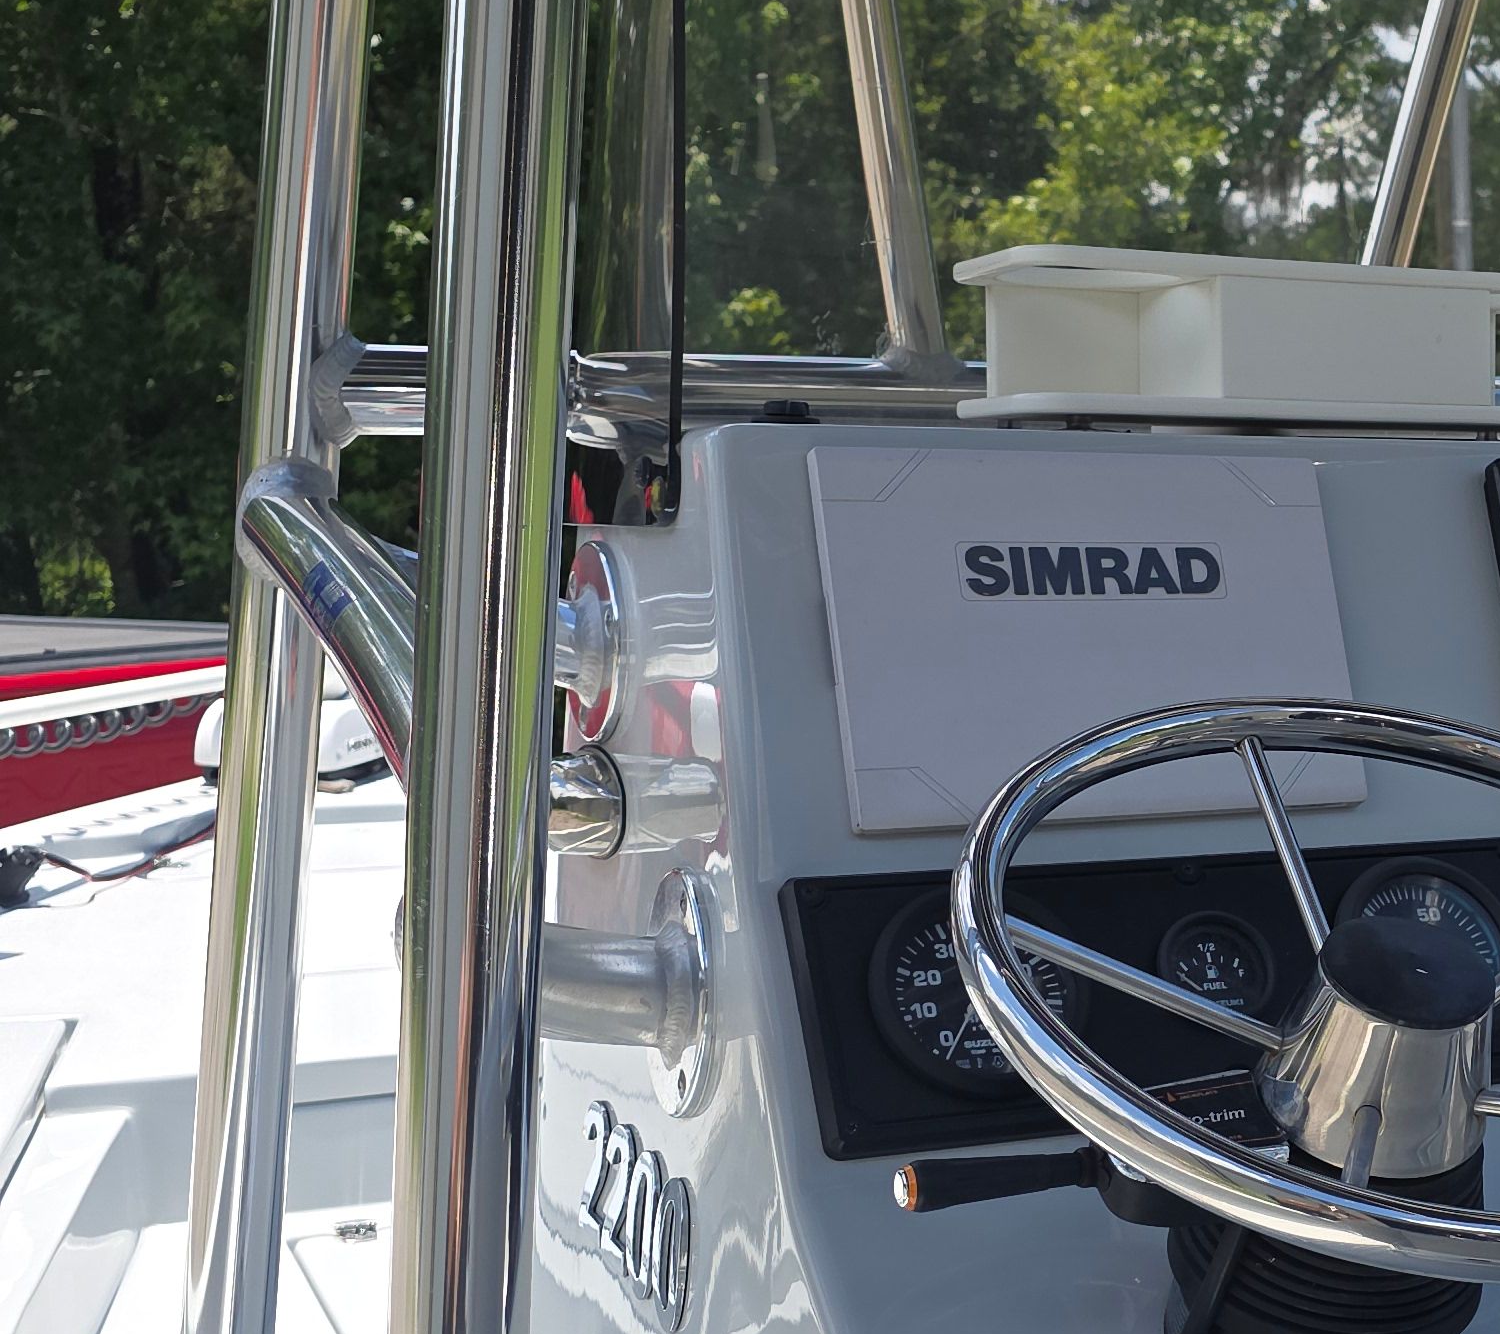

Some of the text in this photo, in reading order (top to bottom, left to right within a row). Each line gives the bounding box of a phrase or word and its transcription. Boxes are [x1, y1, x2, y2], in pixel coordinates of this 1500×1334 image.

[964, 545, 1221, 595] SIMRAD
[1416, 907, 1441, 922] 50
[1197, 943, 1216, 952] 1/2
[912, 969, 942, 987] 20
[1238, 968, 1245, 978] F
[1202, 981, 1228, 991] FUEL
[910, 1002, 937, 1019] 10
[939, 1030, 955, 1047] 0
[578, 1100, 696, 1332] 2200
